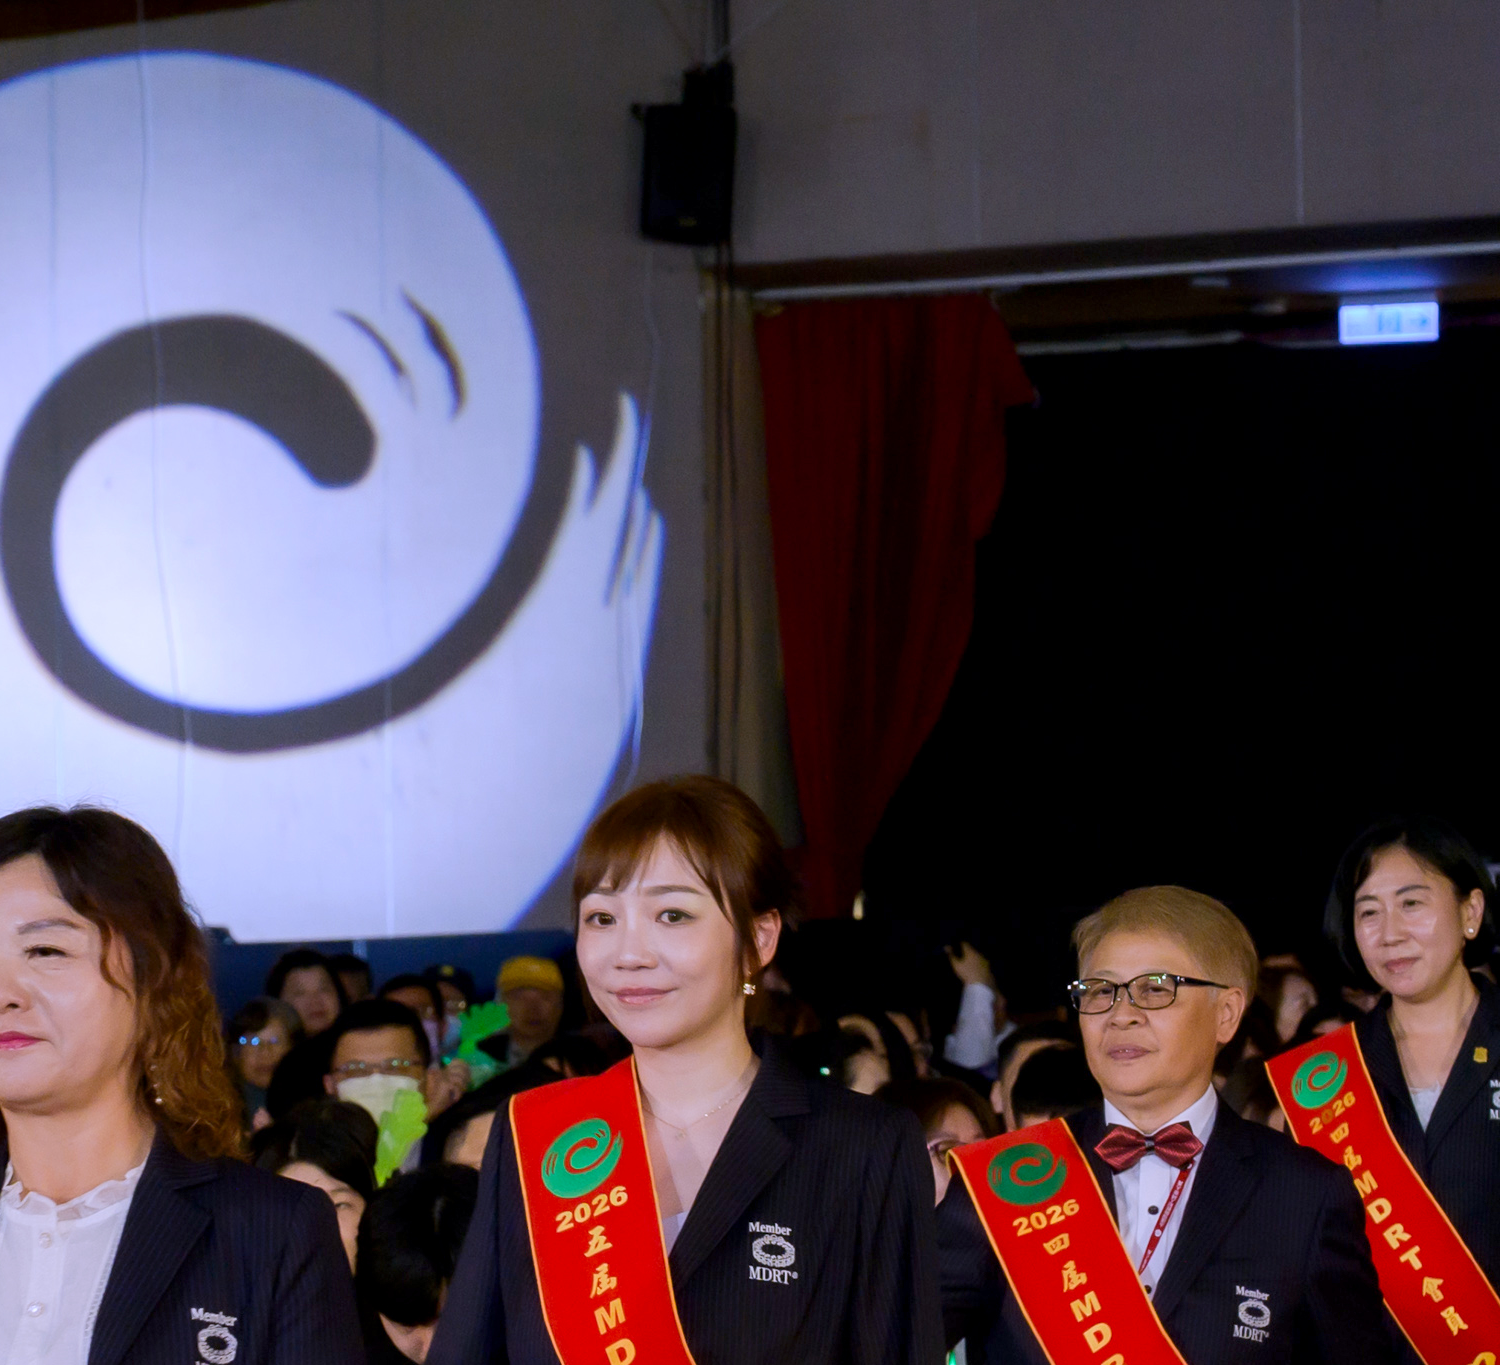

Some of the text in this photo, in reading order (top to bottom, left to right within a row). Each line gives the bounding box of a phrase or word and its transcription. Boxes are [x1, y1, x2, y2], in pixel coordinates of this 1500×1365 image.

[1309, 1091, 1357, 1135] 2026
[554, 1185, 629, 1233] 2026
[1012, 1198, 1080, 1237] 2026
[748, 1221, 792, 1237] Member
[1235, 1285, 1270, 1301] Member
[190, 1308, 237, 1327] Member
